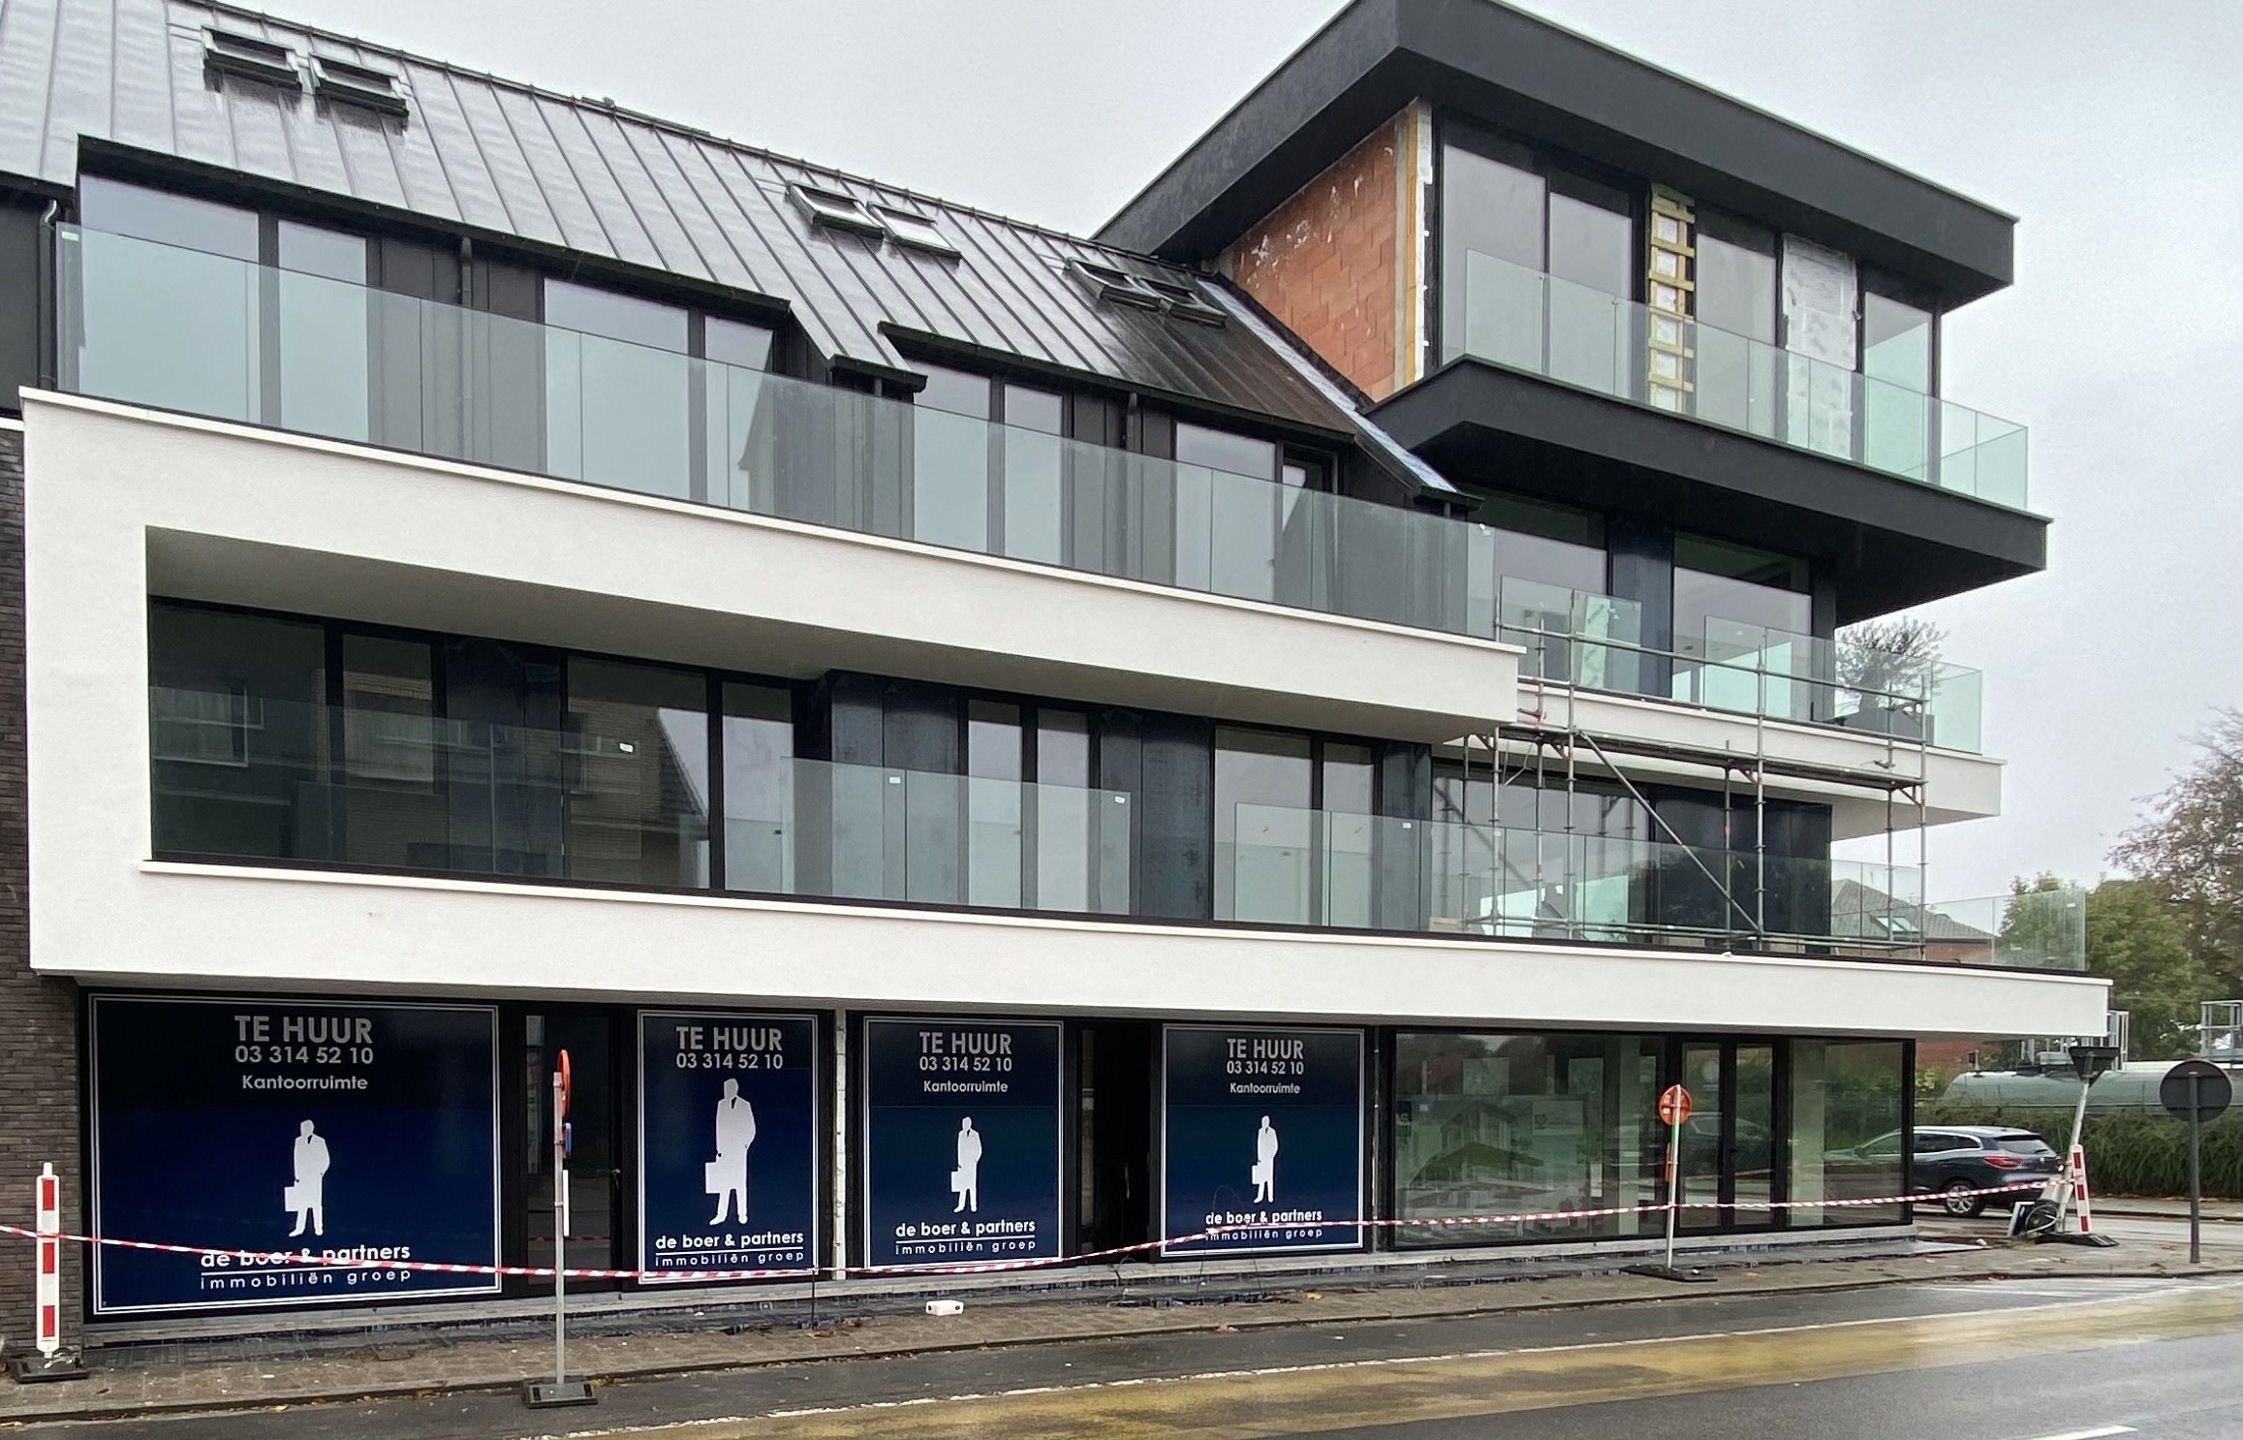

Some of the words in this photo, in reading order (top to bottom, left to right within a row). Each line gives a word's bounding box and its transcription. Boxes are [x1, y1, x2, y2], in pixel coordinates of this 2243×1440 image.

[234, 1015, 270, 1042] TE
[283, 1016, 373, 1044] HUUR
[675, 1026, 703, 1050] TE
[713, 1027, 783, 1051] HUUR
[919, 1031, 943, 1054] TE
[951, 1032, 1012, 1055] HUUR
[1226, 1038, 1247, 1058] TE
[1253, 1039, 1304, 1060] HUUR
[235, 1045, 262, 1063] 03
[269, 1045, 309, 1064] 314
[315, 1046, 342, 1064] 52
[349, 1047, 374, 1065] 10
[676, 1052, 697, 1069] 03
[702, 1053, 733, 1069] 314
[738, 1053, 759, 1069] 52
[764, 1054, 783, 1070] 10
[919, 1056, 938, 1071] 03
[942, 1056, 969, 1071] 314
[973, 1057, 991, 1072] 52
[995, 1057, 1012, 1072] 10
[1226, 1060, 1242, 1074] 03
[1245, 1060, 1268, 1074] 314
[1270, 1061, 1286, 1075] 52
[1290, 1061, 1304, 1075] 10
[242, 1075, 368, 1090] Kantoorruimte
[923, 1080, 1009, 1093] Kantoorruimte
[1230, 1082, 1301, 1094] Kantoorruimte
[1205, 1211, 1223, 1225] de
[1226, 1211, 1257, 1224] boer
[1259, 1210, 1268, 1223] &
[1271, 1208, 1323, 1225] partners
[895, 1222, 917, 1238] de
[920, 1221, 957, 1236] boer
[960, 1221, 971, 1235] &
[975, 1219, 1036, 1237] partners
[1285, 1228, 1323, 1240] groep
[655, 1235, 678, 1250] de
[682, 1234, 720, 1249] boer
[724, 1233, 736, 1247] &
[740, 1230, 804, 1249] partners
[895, 1241, 983, 1255] immobiliën
[991, 1240, 1036, 1253] groep
[200, 1249, 231, 1267] de
[322, 1244, 411, 1266] partners
[655, 1253, 749, 1267] immobiliën
[757, 1251, 804, 1265] groep
[200, 1271, 333, 1290] immobiliën
[346, 1269, 411, 1286] groep
